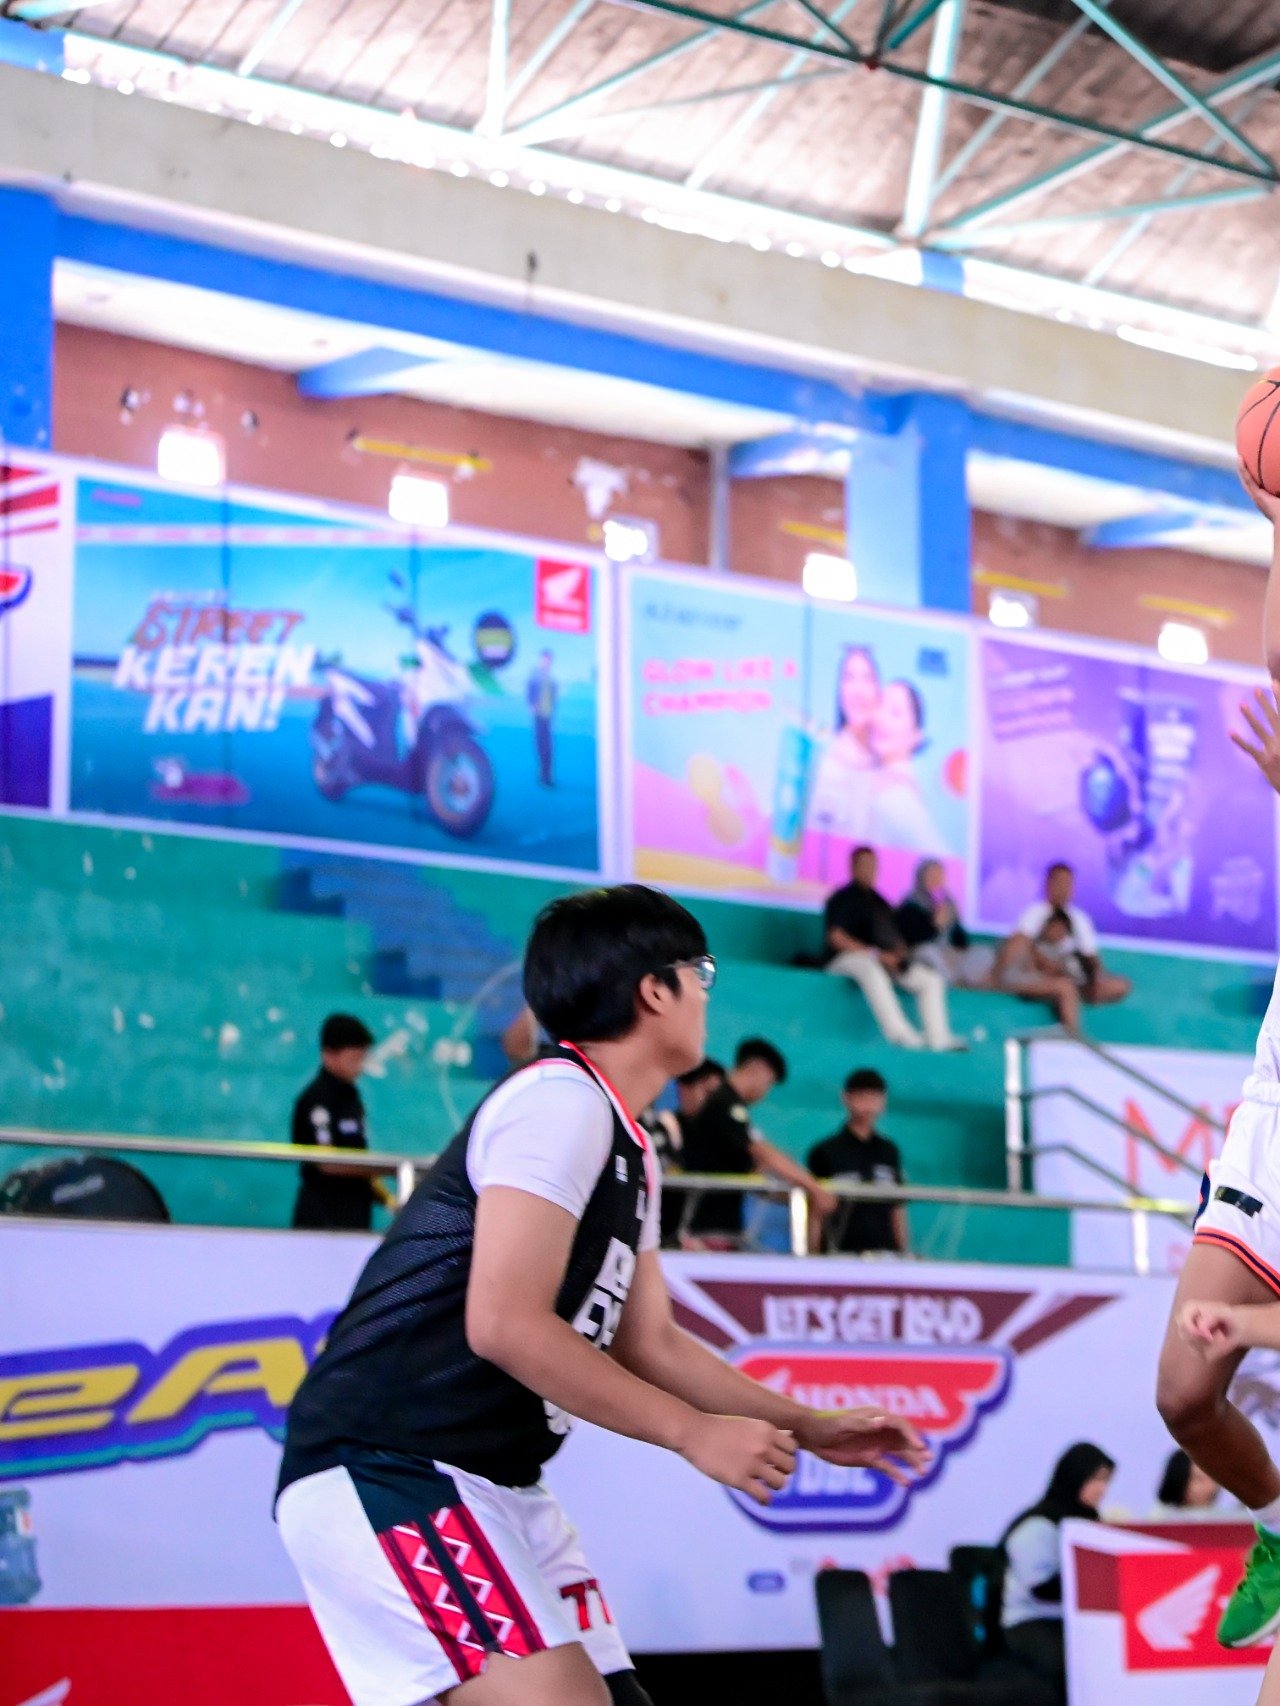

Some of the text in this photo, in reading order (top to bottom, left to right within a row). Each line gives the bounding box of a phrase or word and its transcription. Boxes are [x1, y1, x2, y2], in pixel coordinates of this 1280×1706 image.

[113, 643, 317, 690] KEREN
[143, 690, 286, 734] KAN!
[0, 1337, 328, 1442] eA
